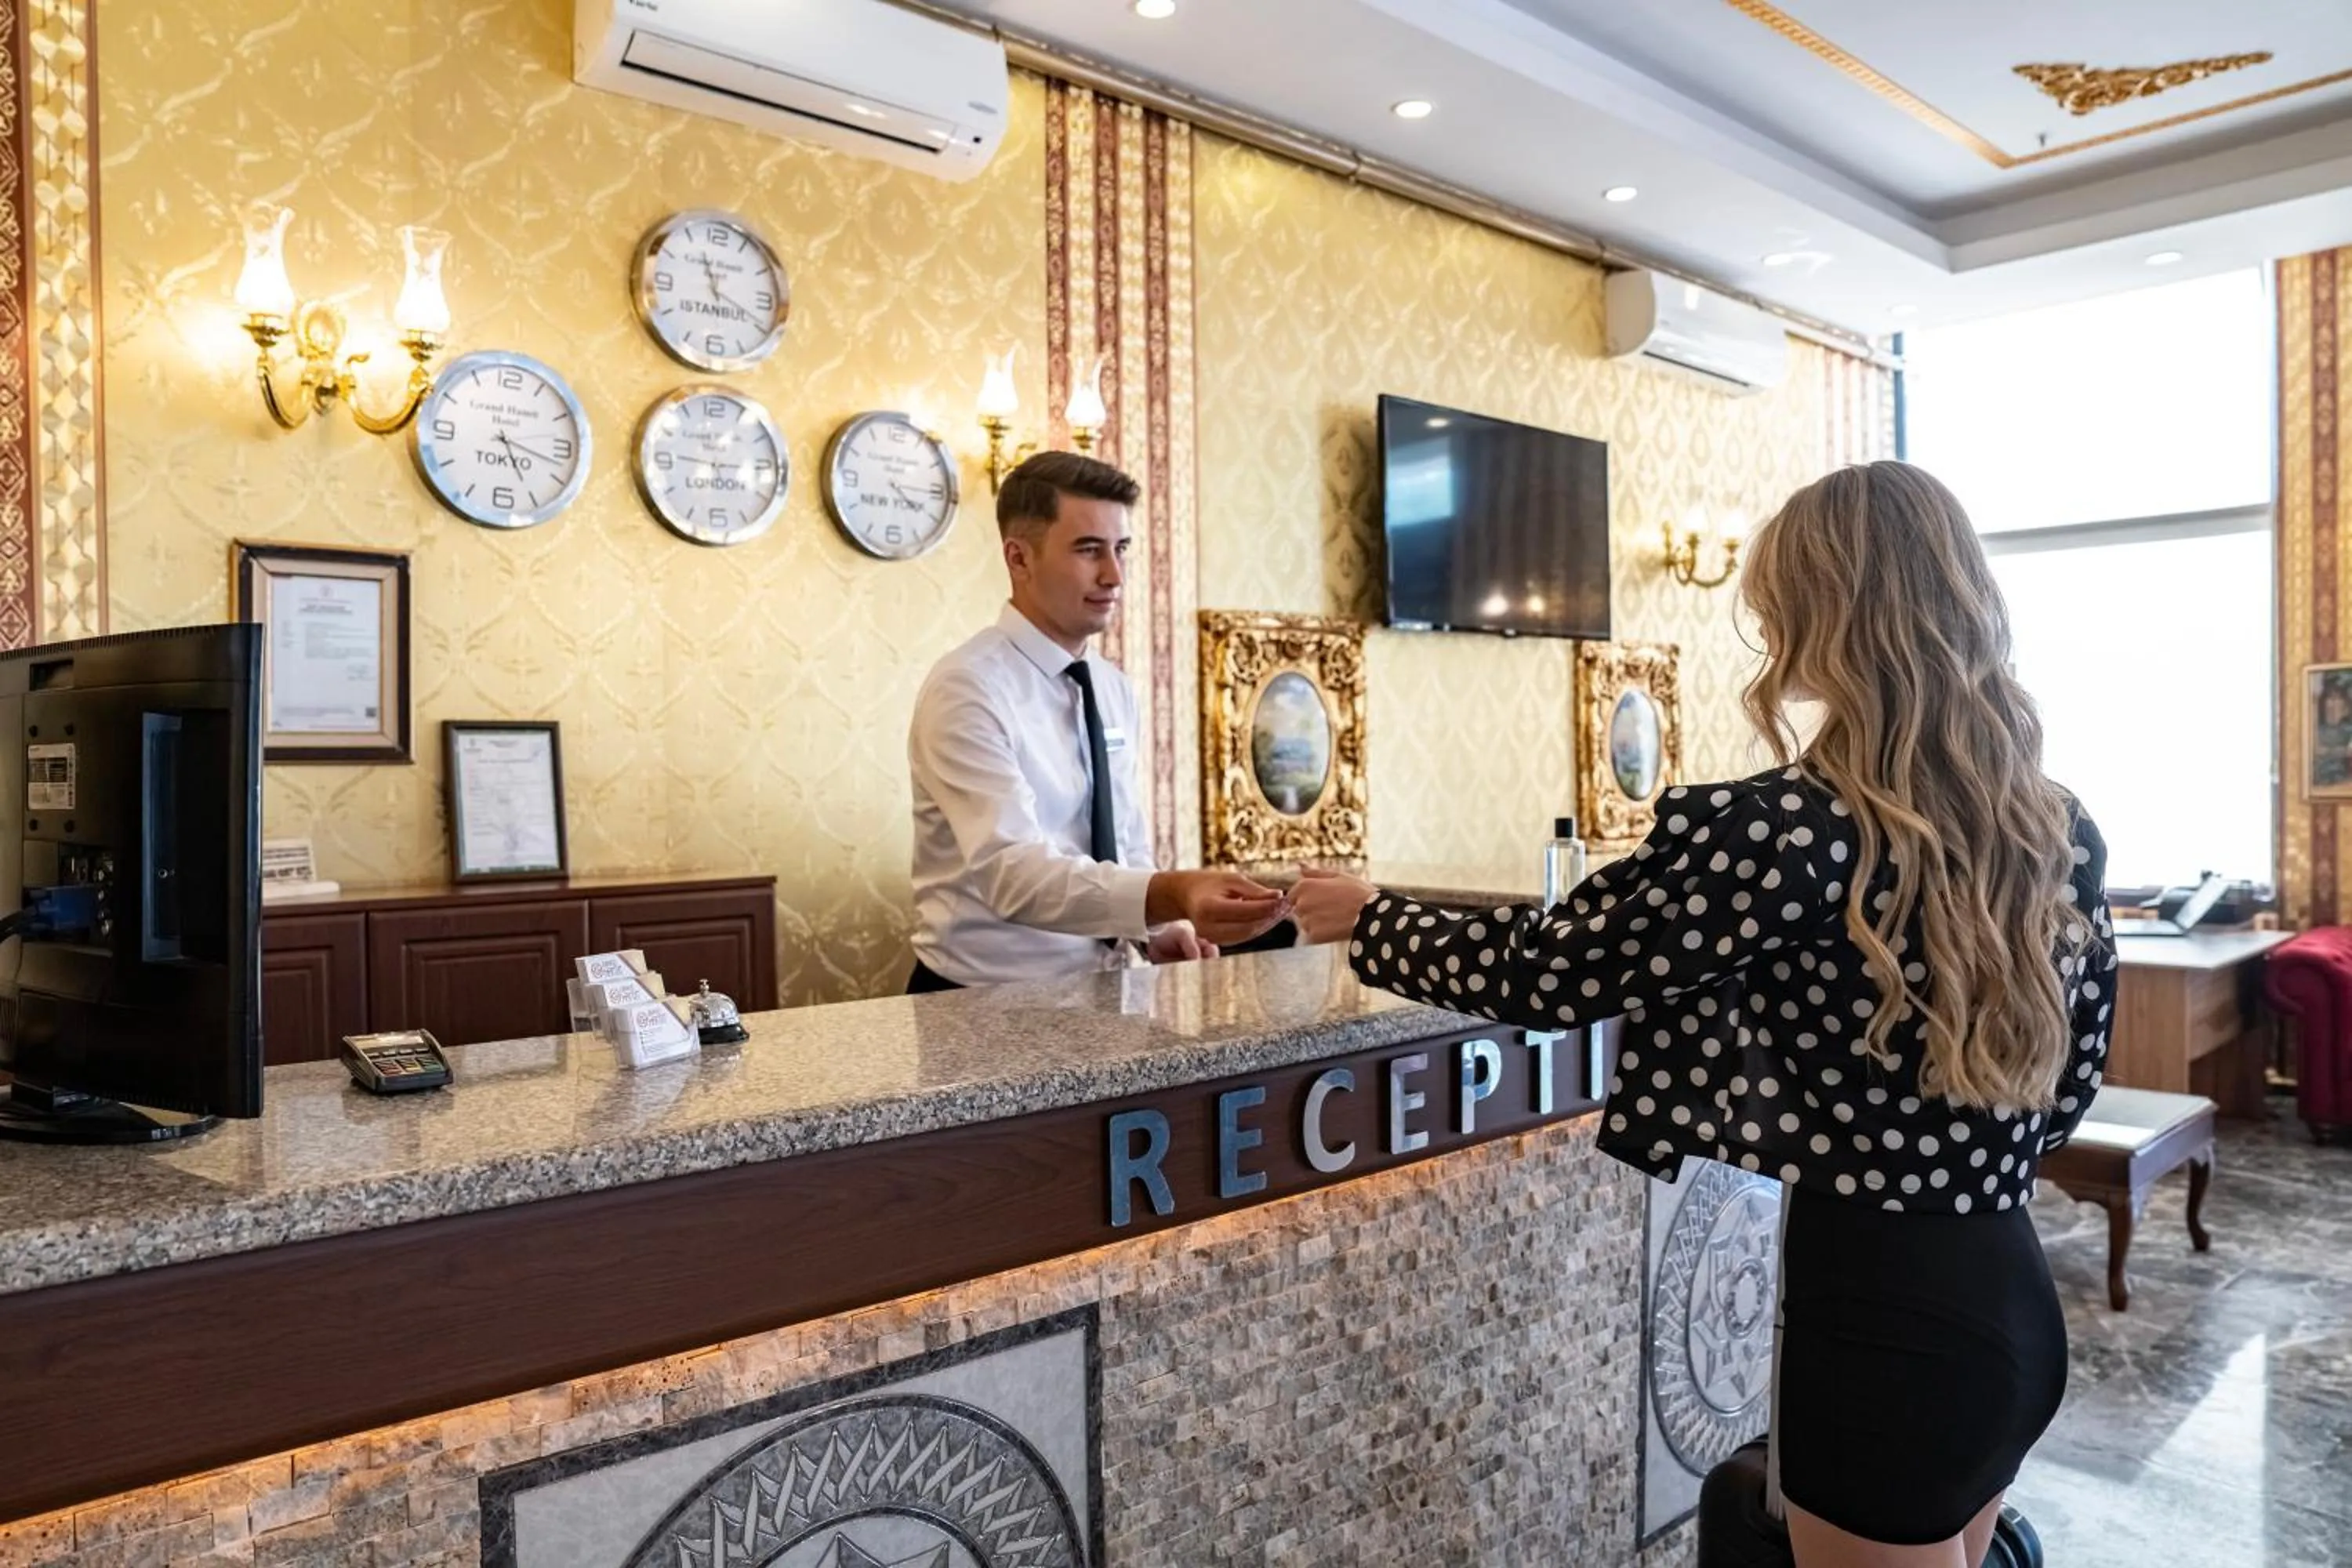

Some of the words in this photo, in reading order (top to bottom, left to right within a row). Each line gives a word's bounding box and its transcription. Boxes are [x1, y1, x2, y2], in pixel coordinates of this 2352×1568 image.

[707, 227, 729, 248] 12
[654, 271, 674, 292] 9
[755, 291, 773, 311] 3
[706, 334, 725, 357] 6
[497, 369, 524, 390] 12
[702, 400, 726, 419] 12
[433, 419, 456, 441] 9
[887, 426, 906, 444] 12
[552, 437, 572, 459] 3
[476, 450, 532, 470] TOKYO
[653, 451, 673, 471] 9
[685, 476, 746, 492] LONDON
[841, 469, 859, 488] 9
[492, 486, 515, 510] 6
[860, 493, 888, 507] NEW
[708, 506, 728, 528] 6
[884, 524, 903, 545] 6
[1109, 1022, 1603, 1228] RECEPTI
